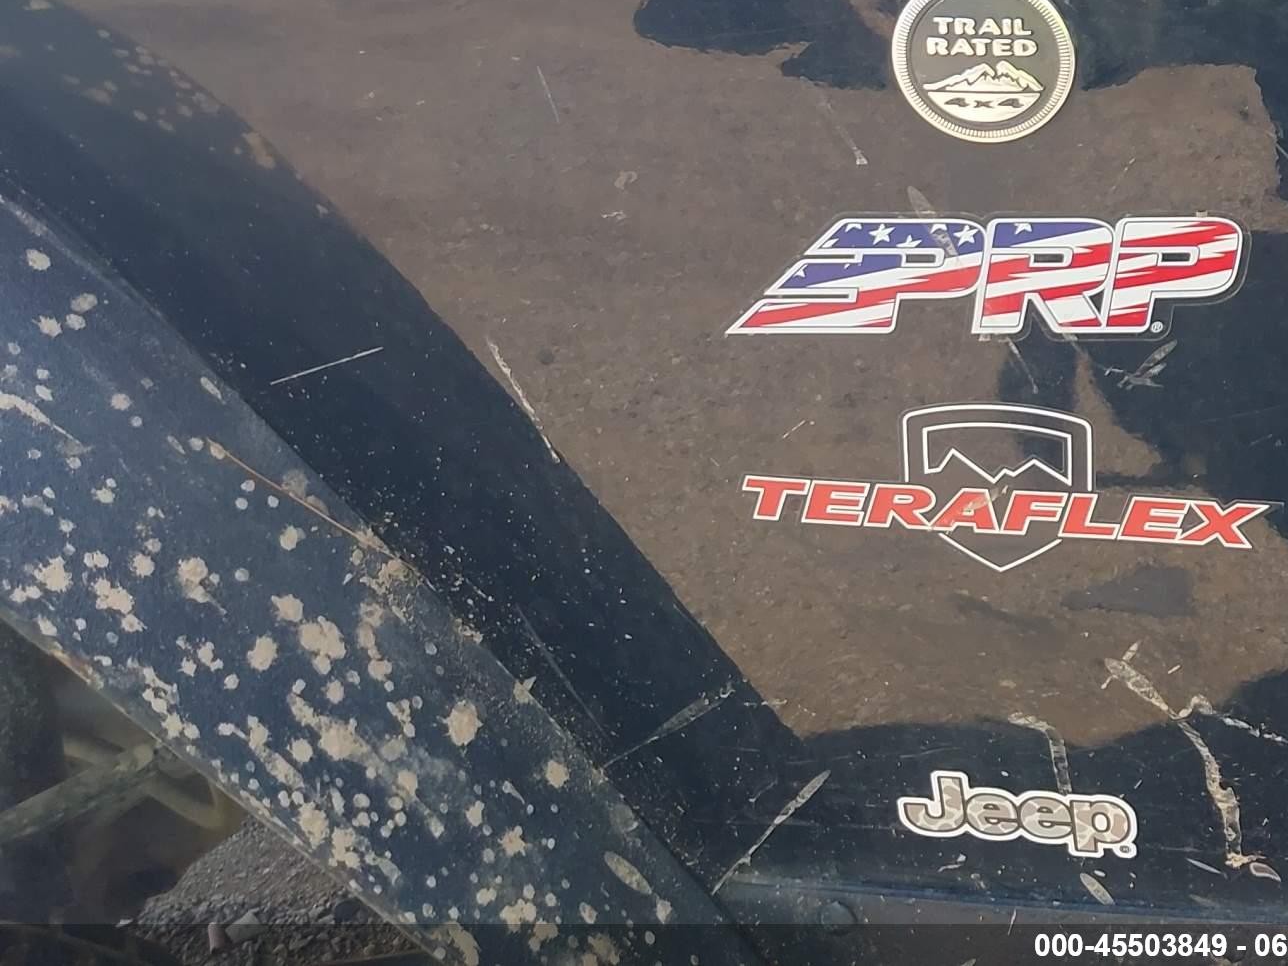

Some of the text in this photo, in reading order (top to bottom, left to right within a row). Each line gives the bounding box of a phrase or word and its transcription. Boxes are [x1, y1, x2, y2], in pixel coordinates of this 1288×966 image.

[926, 37, 1038, 57] RATED
[932, 16, 1032, 36] TRAIL
[742, 474, 1270, 549] TERAFLEX
[898, 771, 1137, 857] Jeep
